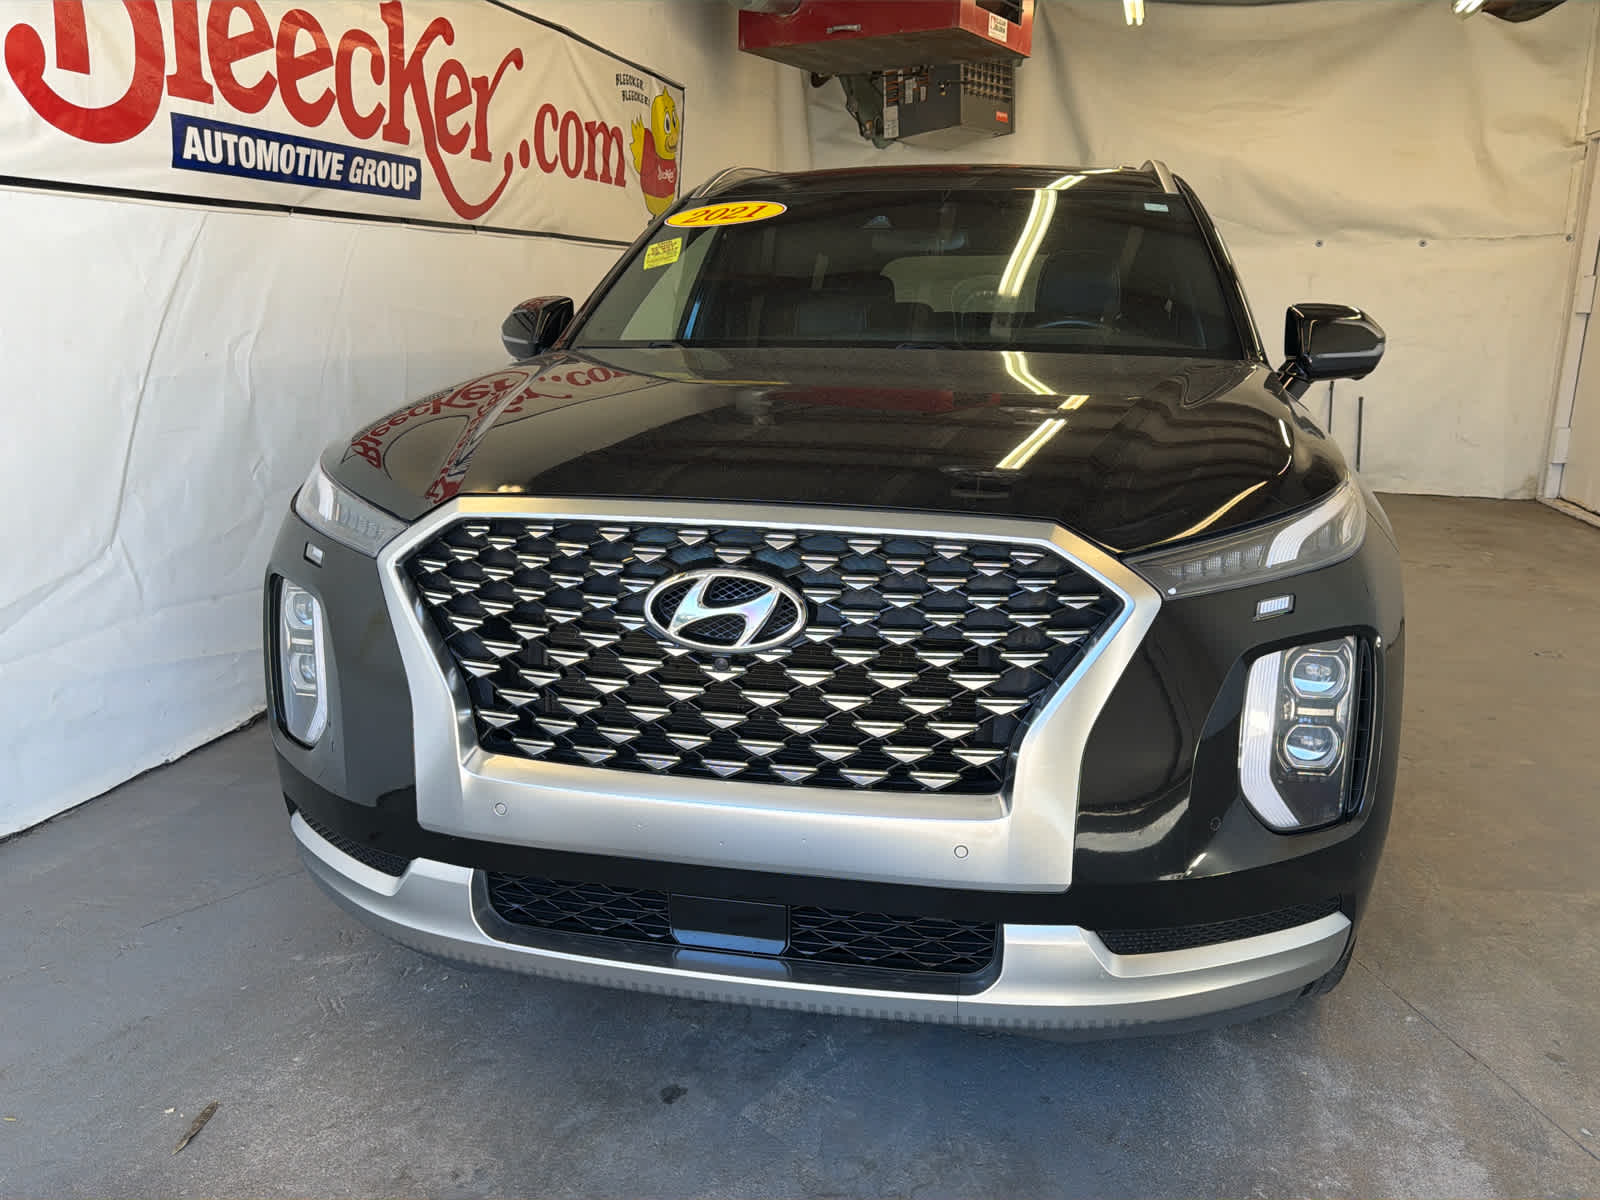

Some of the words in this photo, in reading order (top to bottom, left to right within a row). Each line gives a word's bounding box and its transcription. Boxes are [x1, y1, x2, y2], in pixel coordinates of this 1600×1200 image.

[182, 126, 345, 181] AUTOMOTIVE
[349, 156, 417, 191] GROUP
[680, 205, 768, 224] 2021
